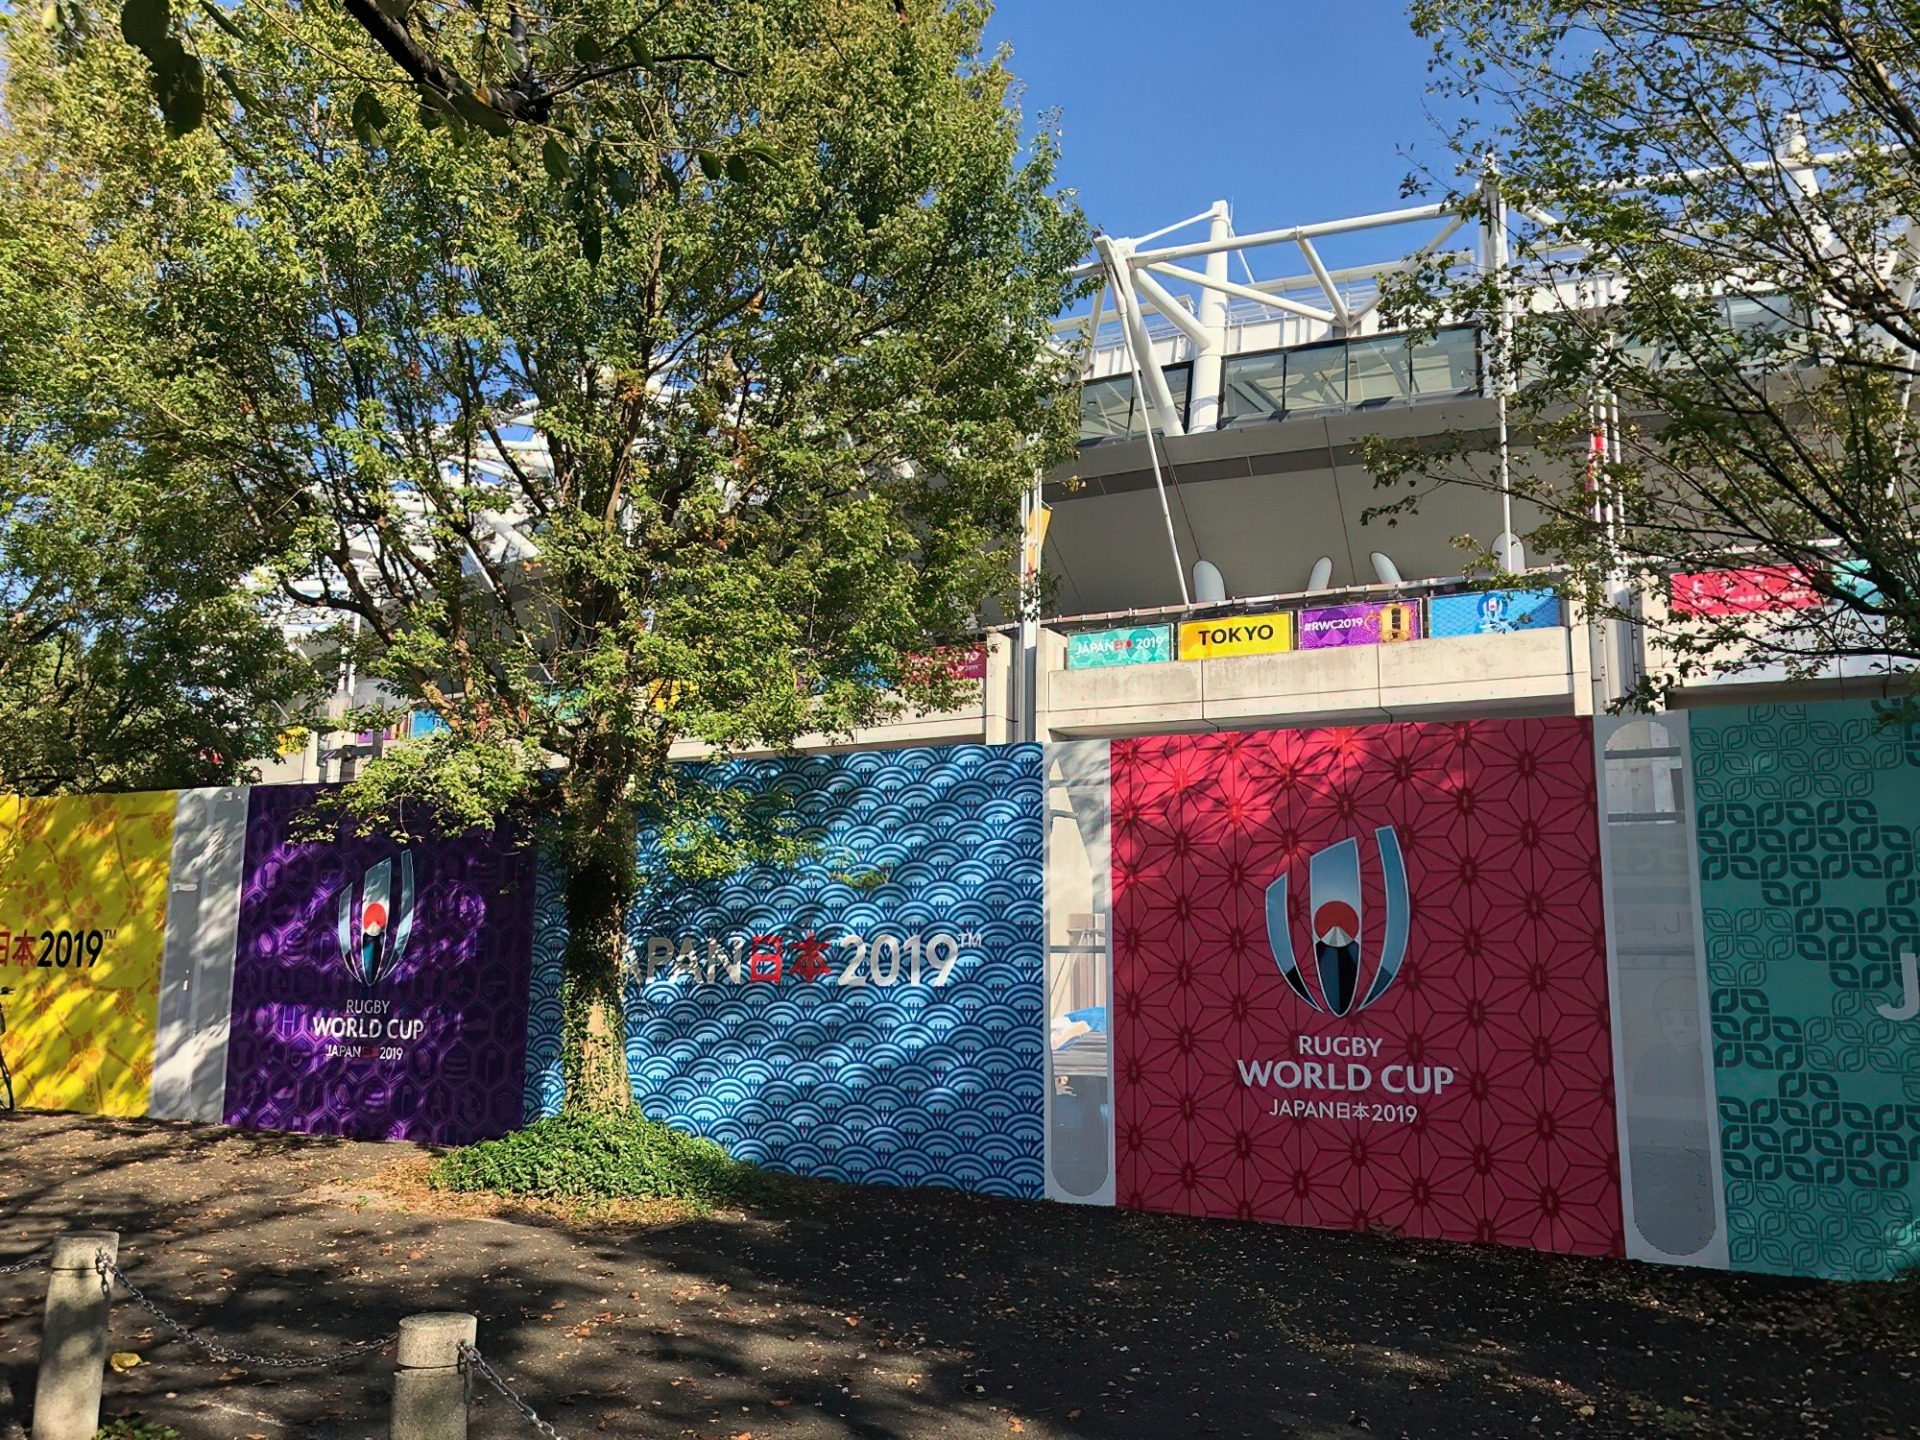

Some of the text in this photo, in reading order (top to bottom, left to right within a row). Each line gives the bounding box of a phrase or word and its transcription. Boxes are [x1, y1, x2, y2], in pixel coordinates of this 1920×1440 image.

[1198, 624, 1274, 646] TOKYO
[1304, 617, 1363, 631] #RWC2019
[346, 999, 391, 1014] RUGBY
[312, 1017, 425, 1040] WORLD CUP
[1298, 1035, 1383, 1058] RUGBY
[1236, 1059, 1455, 1094] WORLD CUP
